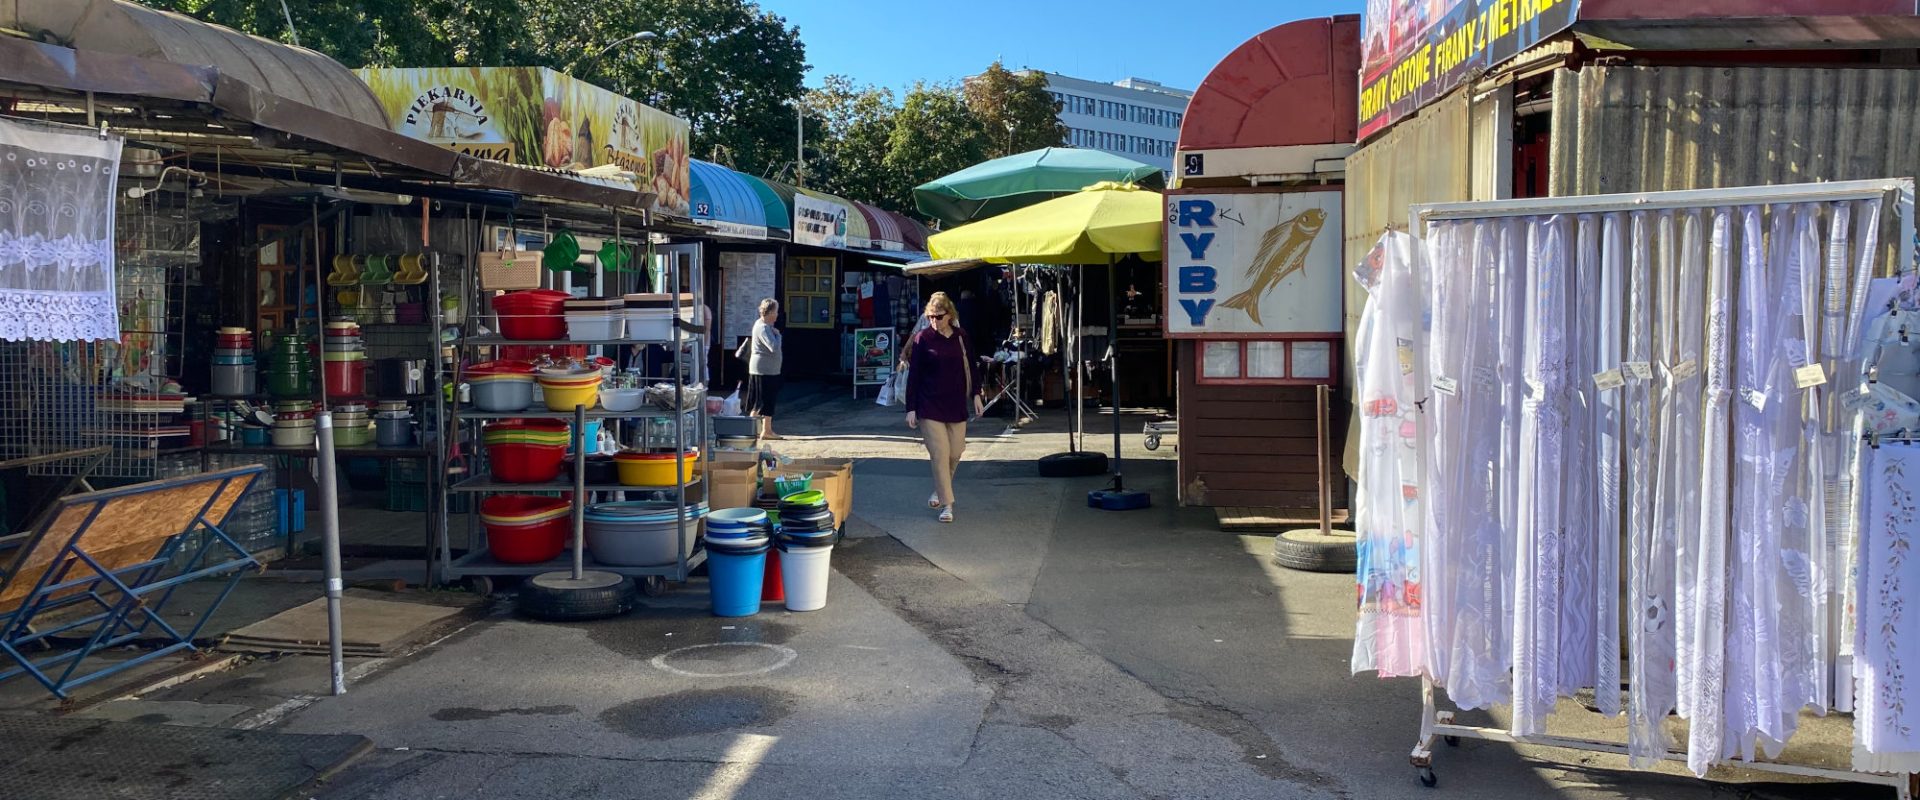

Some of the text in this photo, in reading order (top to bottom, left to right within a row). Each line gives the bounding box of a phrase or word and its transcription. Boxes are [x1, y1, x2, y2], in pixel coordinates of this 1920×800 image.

[1361, 75, 1389, 122] FIRANY
[1391, 43, 1430, 104] GOTOWE
[1435, 18, 1477, 79] FIRANY
[1479, 11, 1487, 52] Z
[406, 87, 488, 126] PIEKARNIA
[697, 203, 709, 215] 52
[1178, 199, 1218, 327] RYBY
